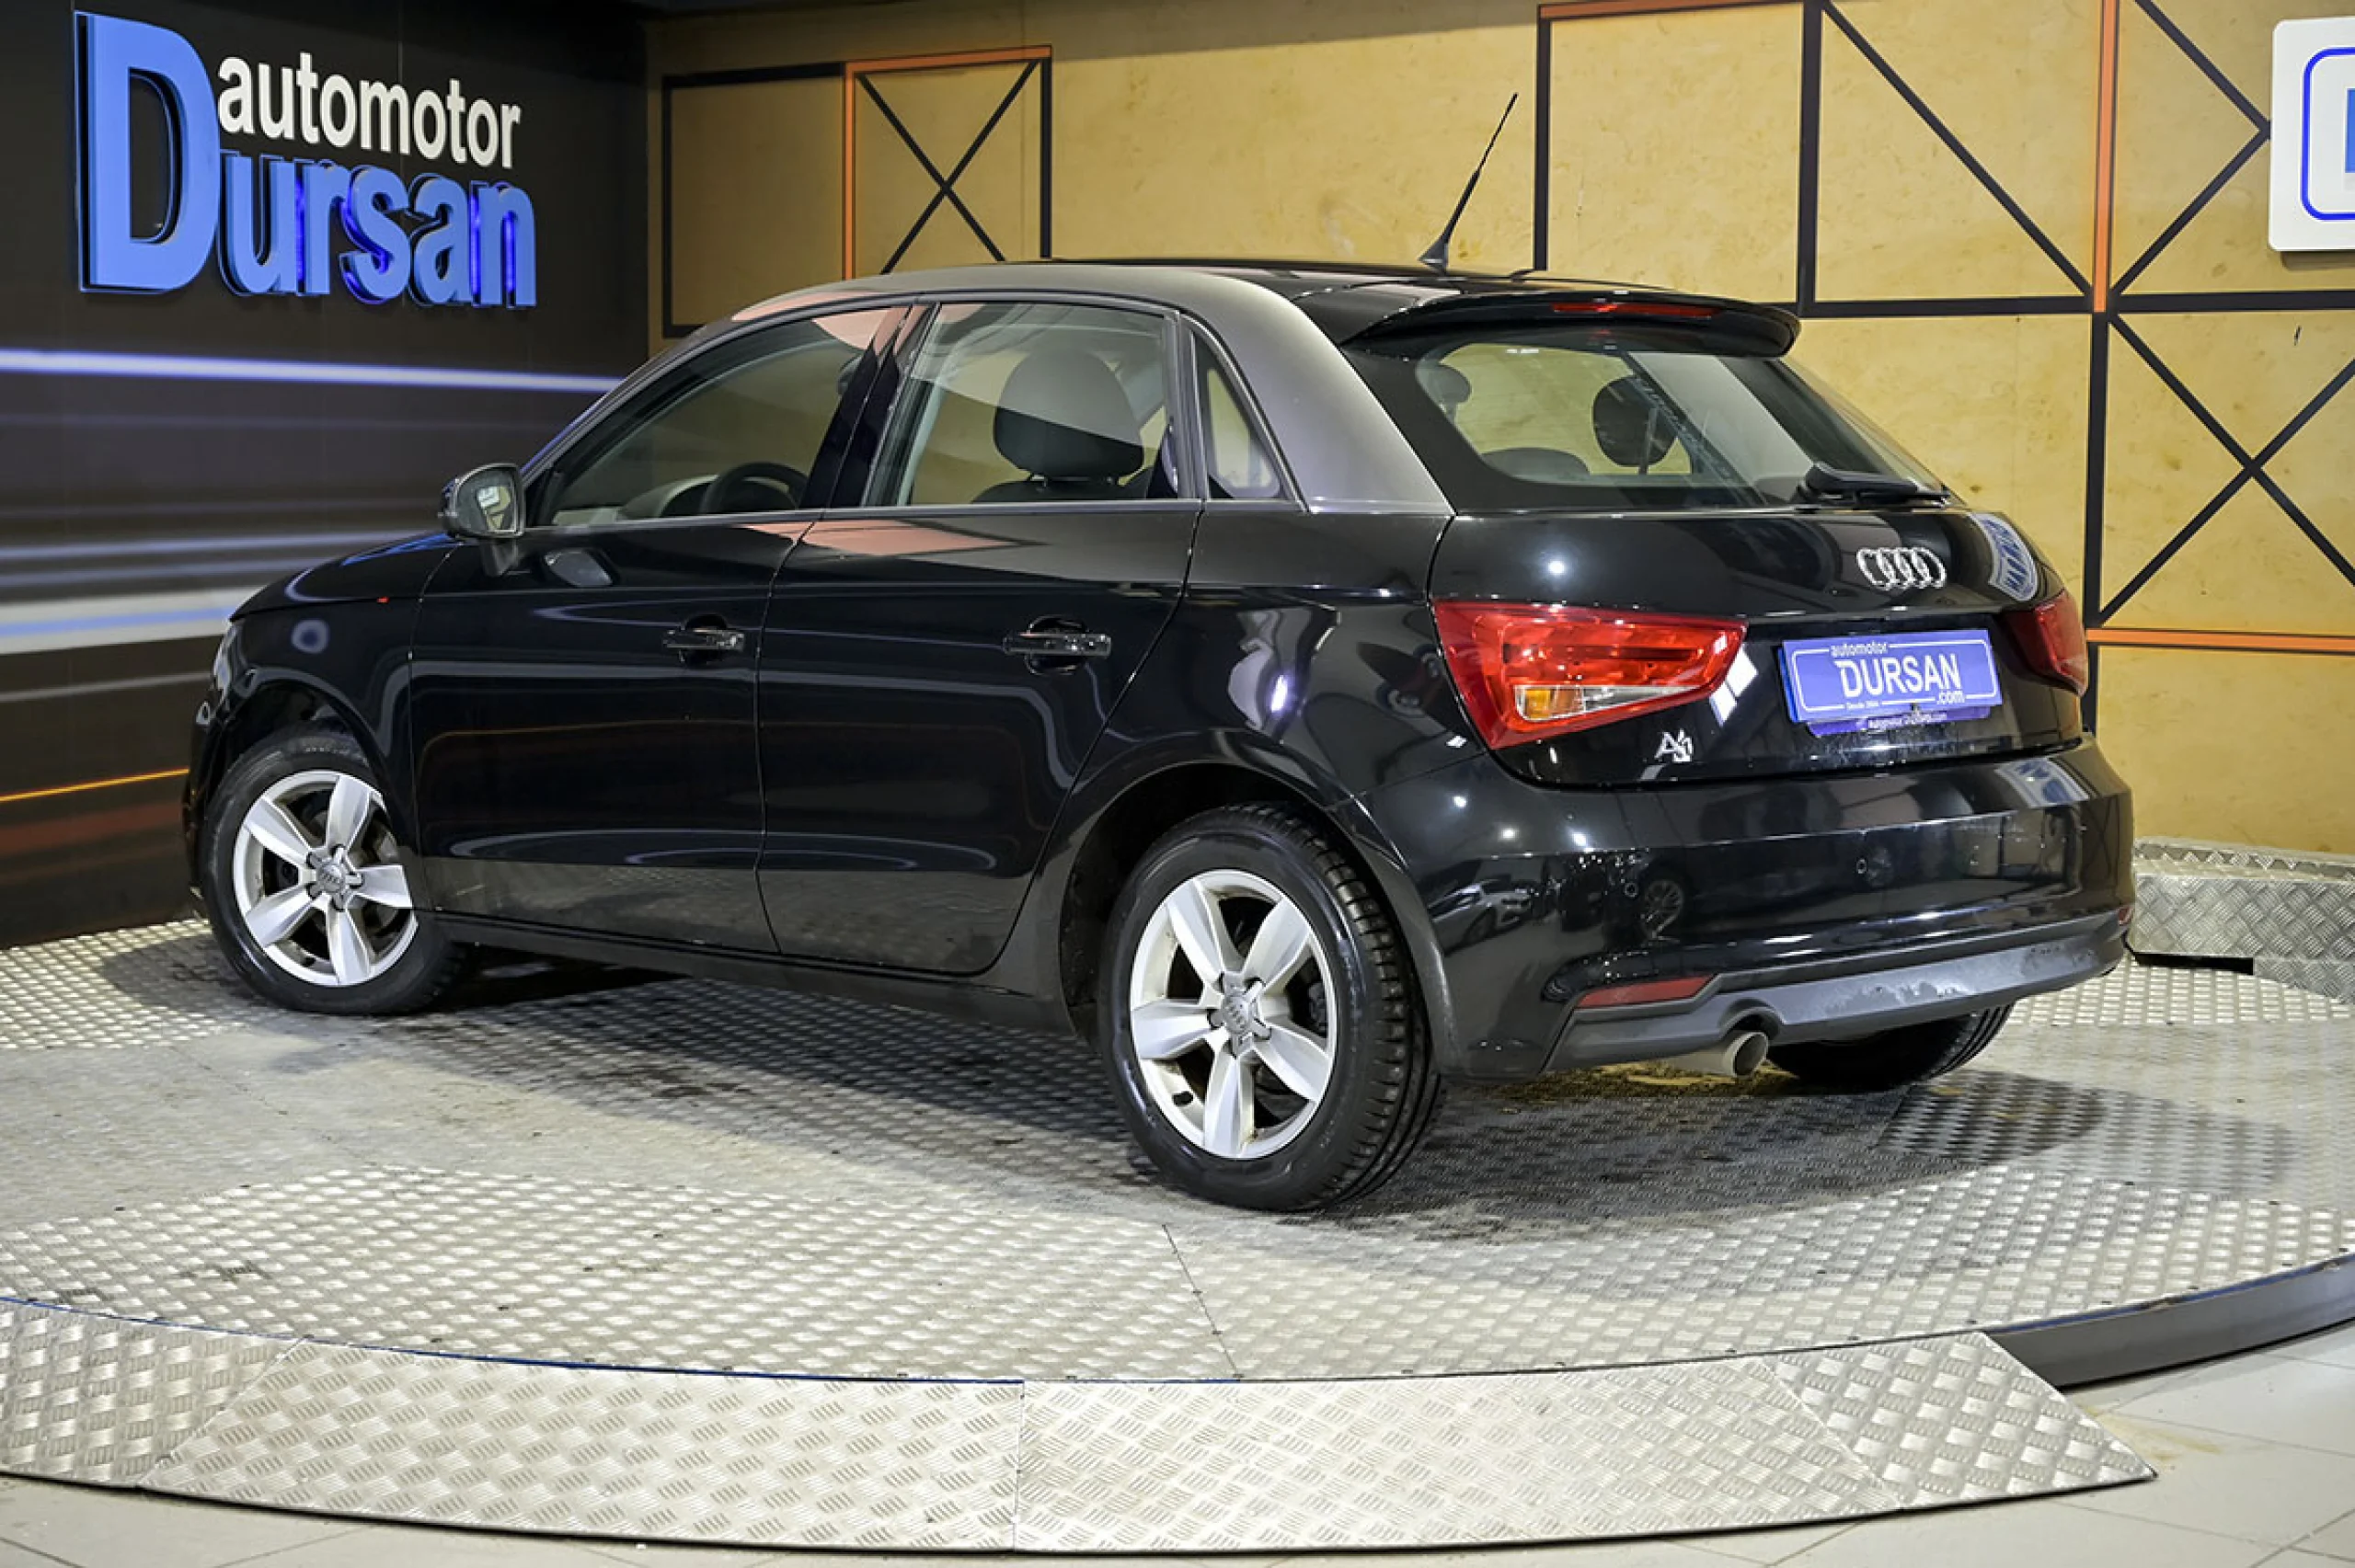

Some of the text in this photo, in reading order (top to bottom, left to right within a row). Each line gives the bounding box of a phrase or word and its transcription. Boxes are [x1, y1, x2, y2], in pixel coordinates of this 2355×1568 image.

[218, 52, 522, 169] automotor
[75, 9, 537, 309] Dursan
[1830, 641, 1889, 658] automotor
[1833, 653, 1962, 698] DURSAN
[1936, 690, 1966, 705] .com
